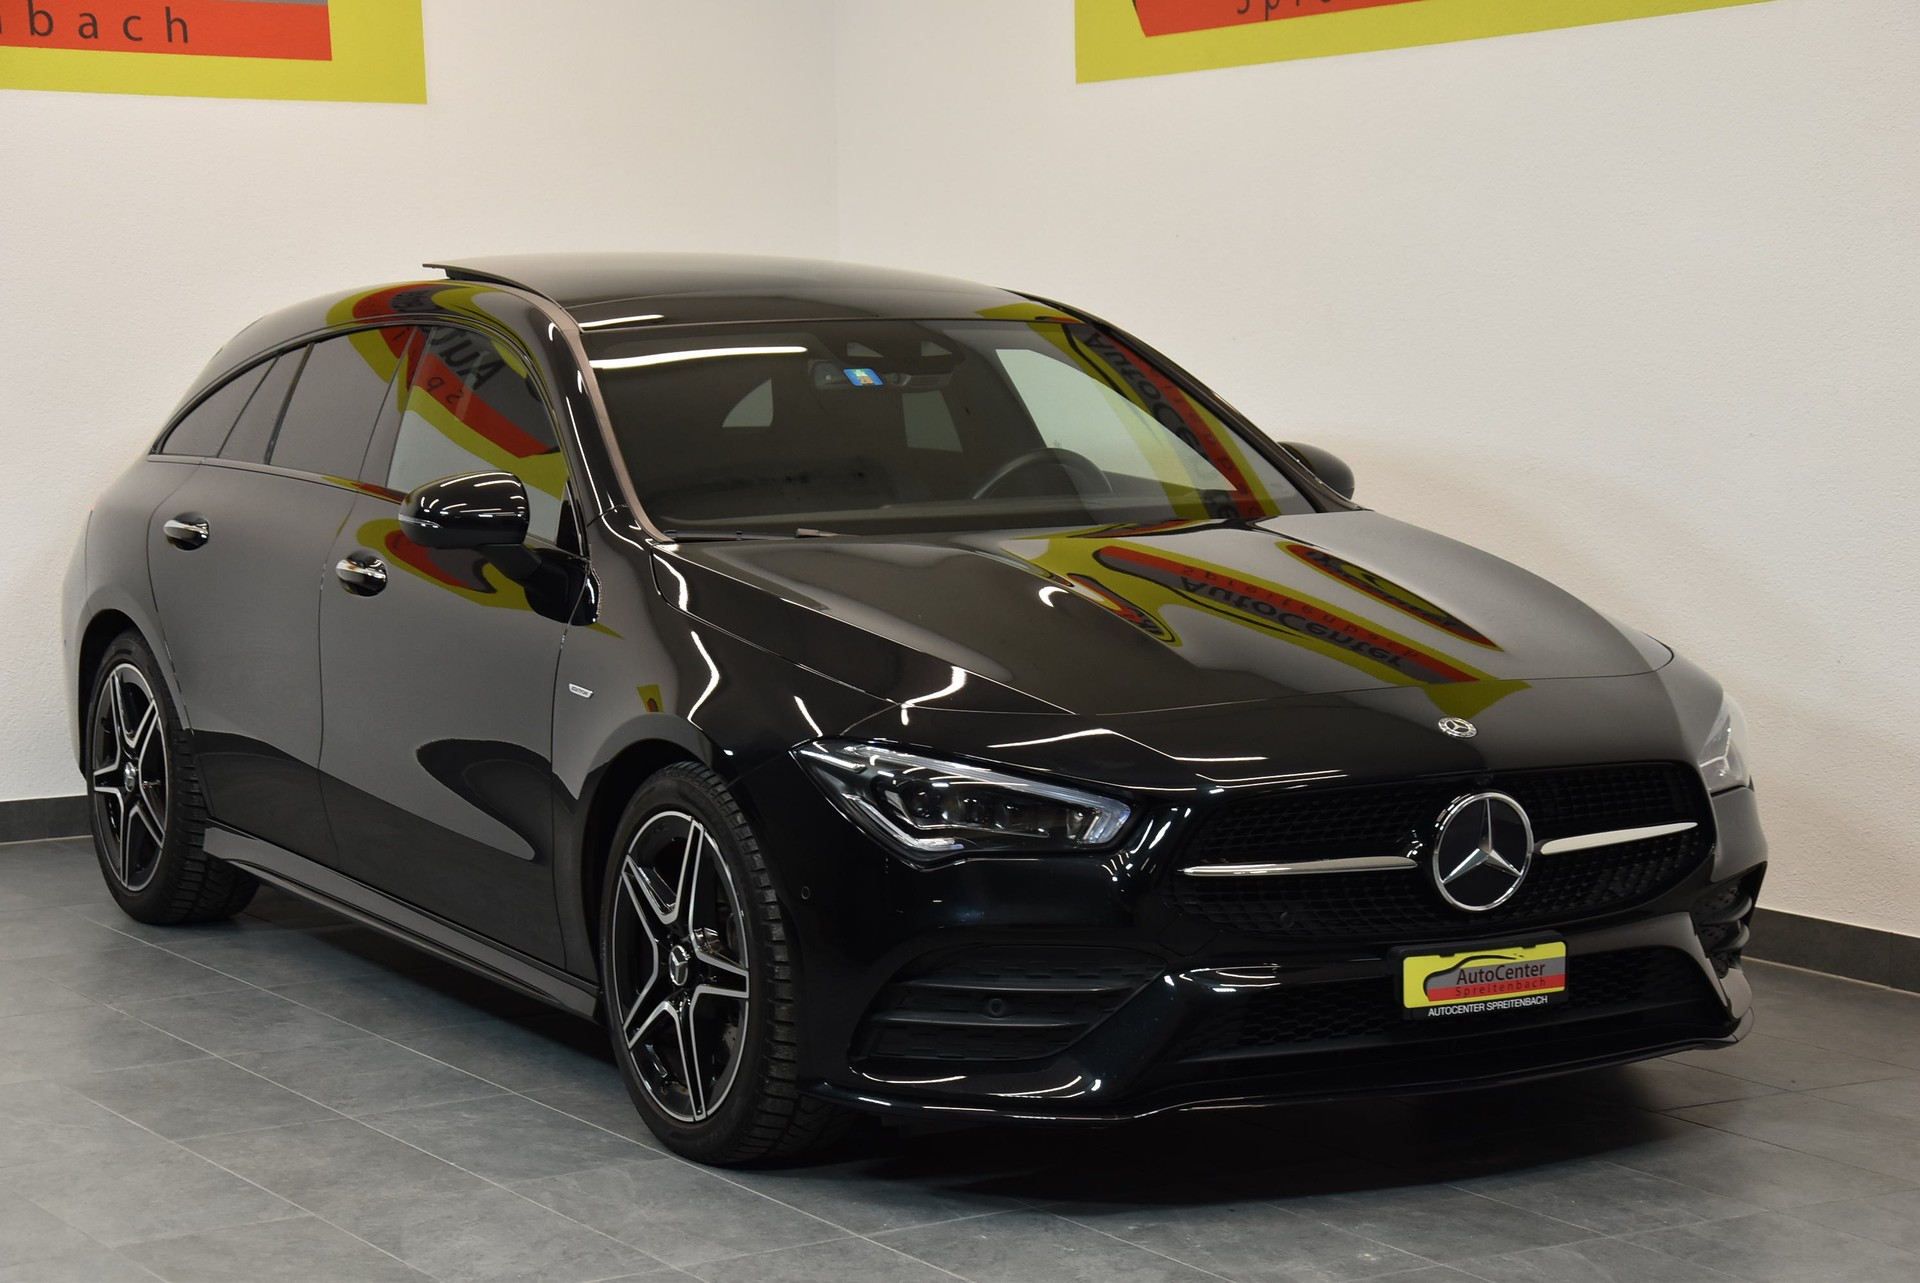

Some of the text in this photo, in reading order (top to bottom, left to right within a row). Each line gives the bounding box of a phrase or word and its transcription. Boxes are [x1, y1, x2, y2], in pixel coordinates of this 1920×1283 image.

[0, 0, 188, 43] bach
[1456, 963, 1546, 985] AutoCenter
[1455, 979, 1546, 998] Spreitenbach
[1428, 995, 1548, 1017] AUTOCENTER SPREITENBACH
